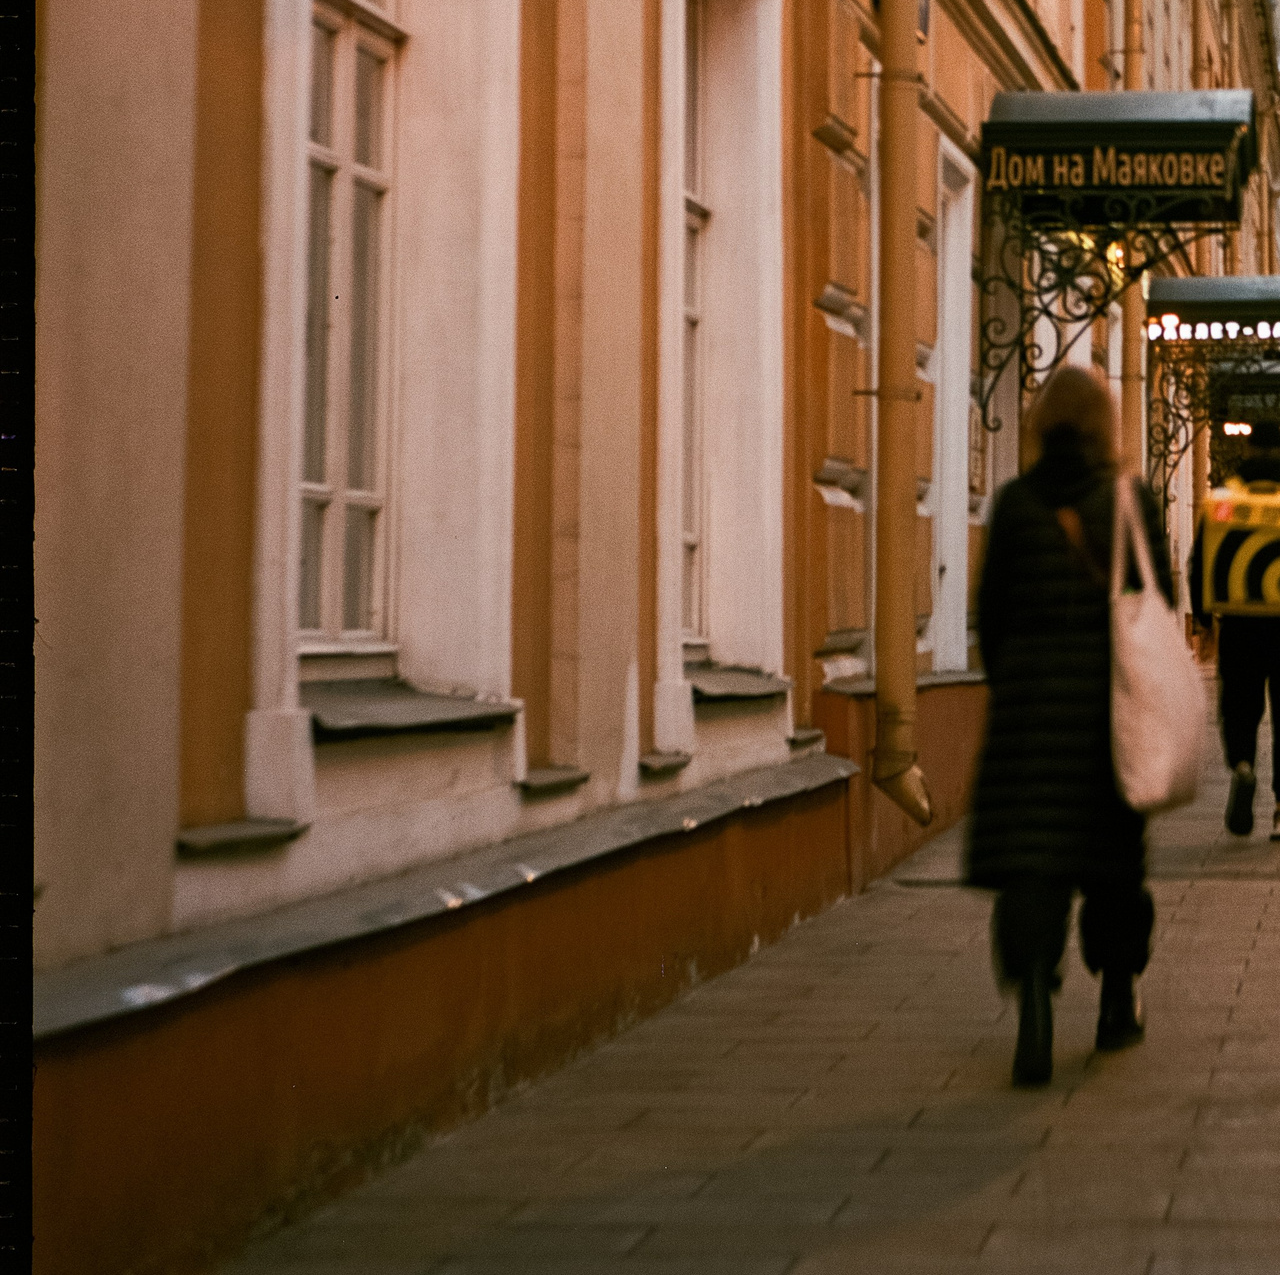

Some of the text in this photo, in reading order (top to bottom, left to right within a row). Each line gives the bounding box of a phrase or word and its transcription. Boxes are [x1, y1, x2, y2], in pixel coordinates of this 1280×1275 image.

[986, 146, 1226, 191] Дом на Маяковке
